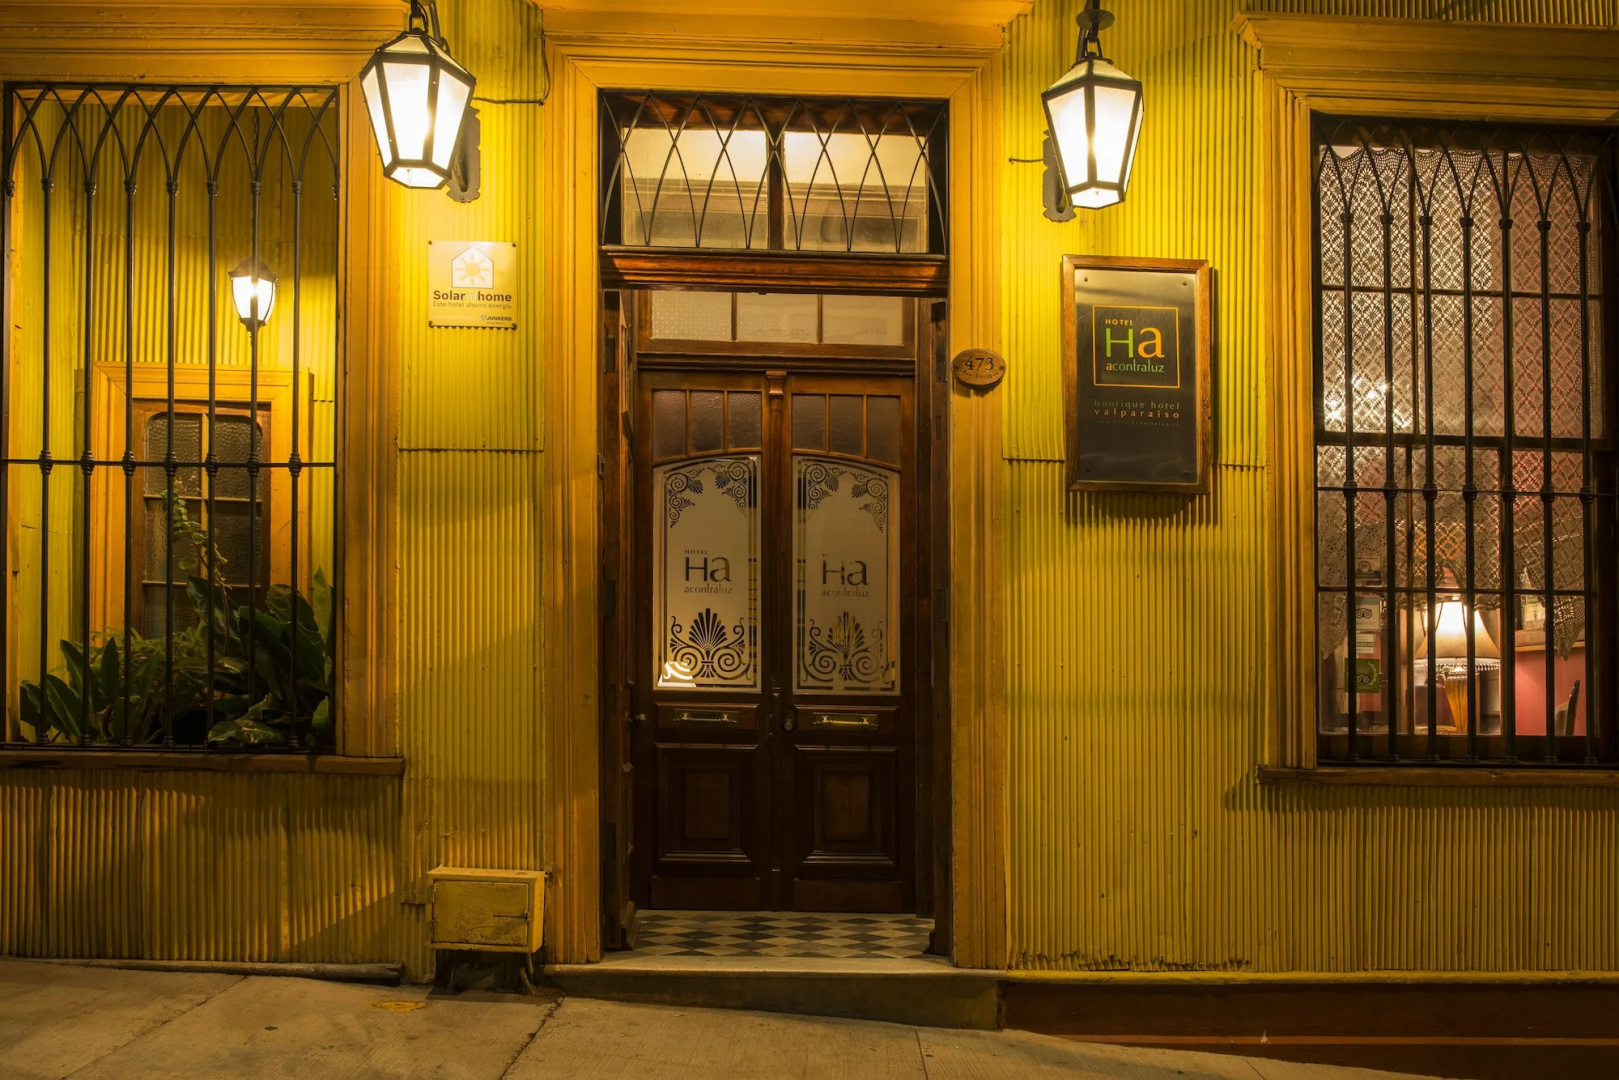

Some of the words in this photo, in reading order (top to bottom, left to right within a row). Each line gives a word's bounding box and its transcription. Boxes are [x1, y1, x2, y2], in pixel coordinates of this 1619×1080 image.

[433, 290, 466, 300] Solar
[477, 291, 512, 302] home
[1105, 327, 1165, 358] Ha
[965, 356, 995, 371] 473
[1106, 359, 1165, 373] acontraluz
[1094, 399, 1146, 410] boutique
[1150, 401, 1180, 410] hotel
[685, 556, 732, 582] Ha
[822, 560, 869, 586] Ha
[684, 582, 733, 594] acontraluz
